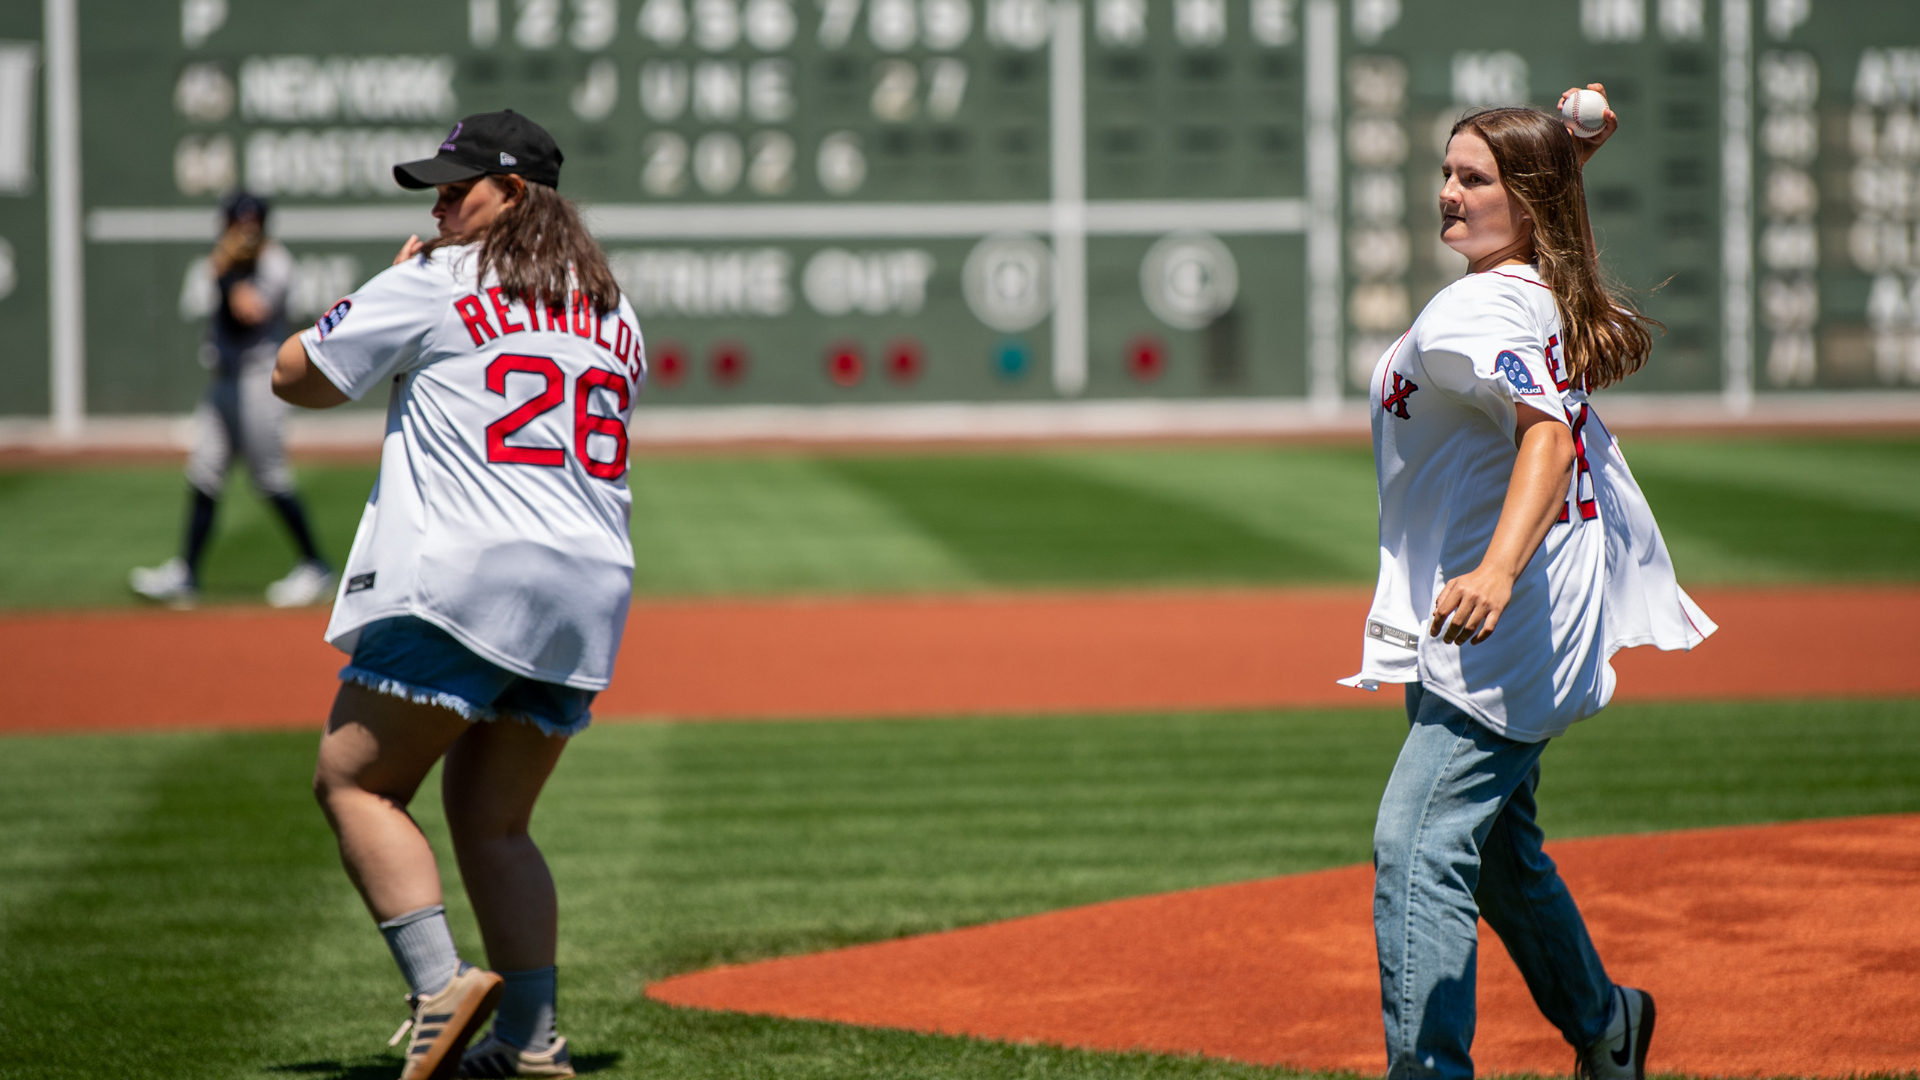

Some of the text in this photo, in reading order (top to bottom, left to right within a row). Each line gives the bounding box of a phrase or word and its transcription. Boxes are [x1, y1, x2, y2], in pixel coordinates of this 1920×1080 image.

[469, 0, 1047, 49] 1 2 3 4 5 6 7 8 9 10
[241, 57, 340, 120] NEW
[339, 57, 455, 120] YORK
[803, 249, 932, 314] OUT
[485, 353, 629, 481] 26
